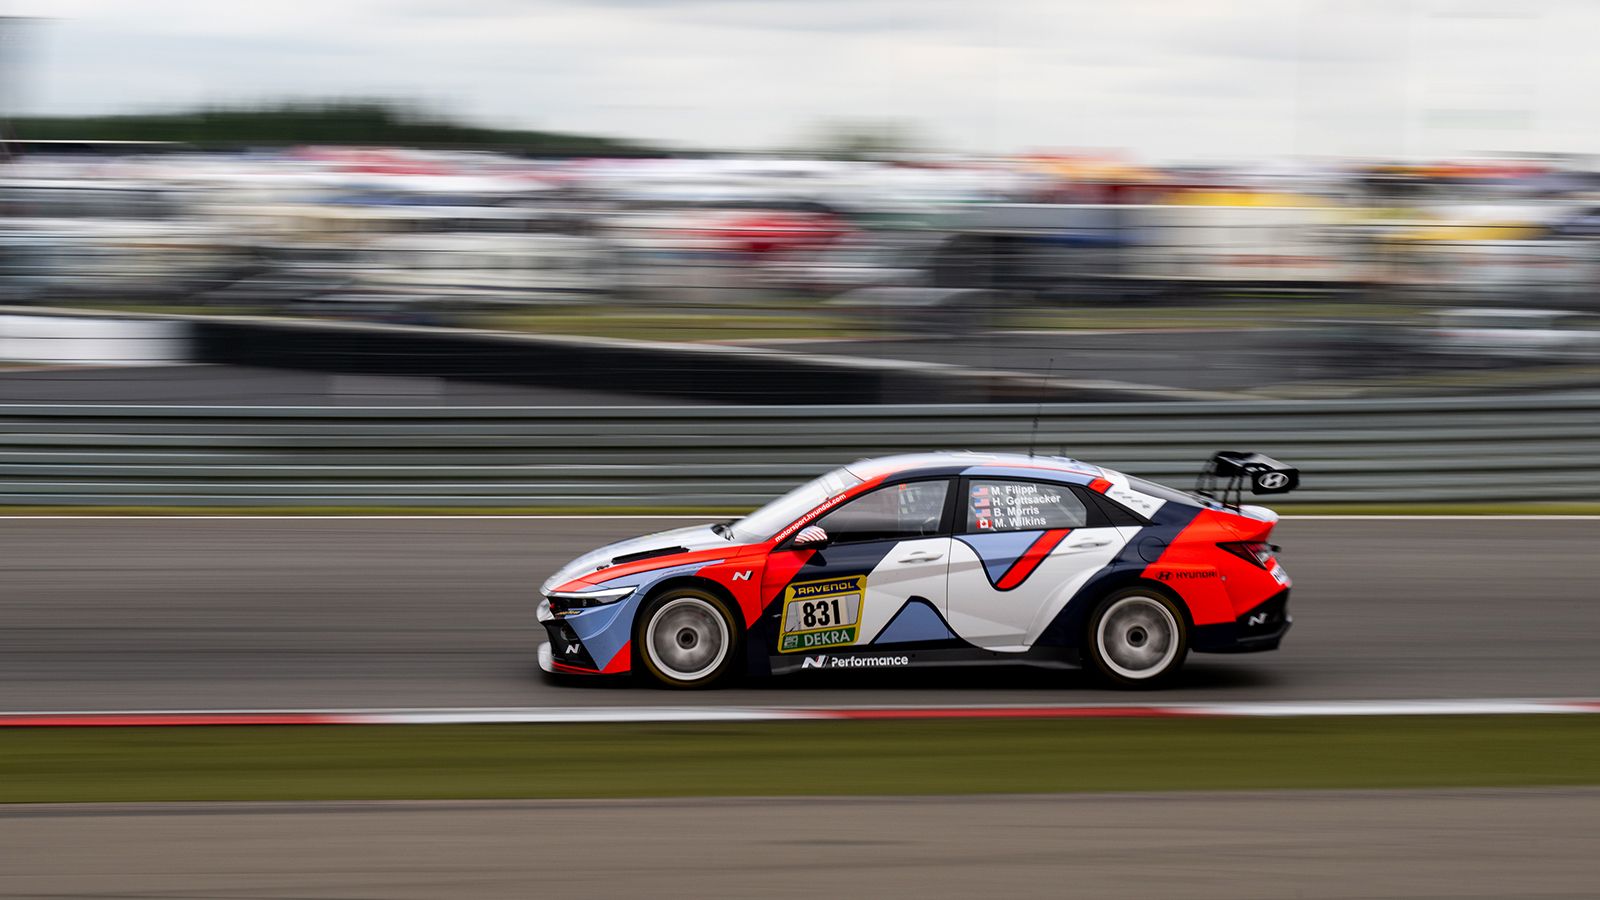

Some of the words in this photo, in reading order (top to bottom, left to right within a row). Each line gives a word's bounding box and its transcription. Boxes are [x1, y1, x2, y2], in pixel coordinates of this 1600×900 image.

[991, 487, 1004, 496] M.
[1005, 484, 1037, 496] Filippi
[992, 498, 1004, 507] H.
[1006, 494, 1061, 506] Gottsacker
[775, 494, 846, 542] motorsport.hyundai.com
[993, 508, 1005, 517] B.
[1007, 506, 1039, 516] Morris
[994, 519, 1007, 528] M.
[1009, 517, 1046, 528] Wilkins
[798, 582, 855, 595] RAVENOL
[802, 599, 841, 628] 831
[804, 630, 851, 647] DEKRA
[831, 656, 909, 667] Performance
